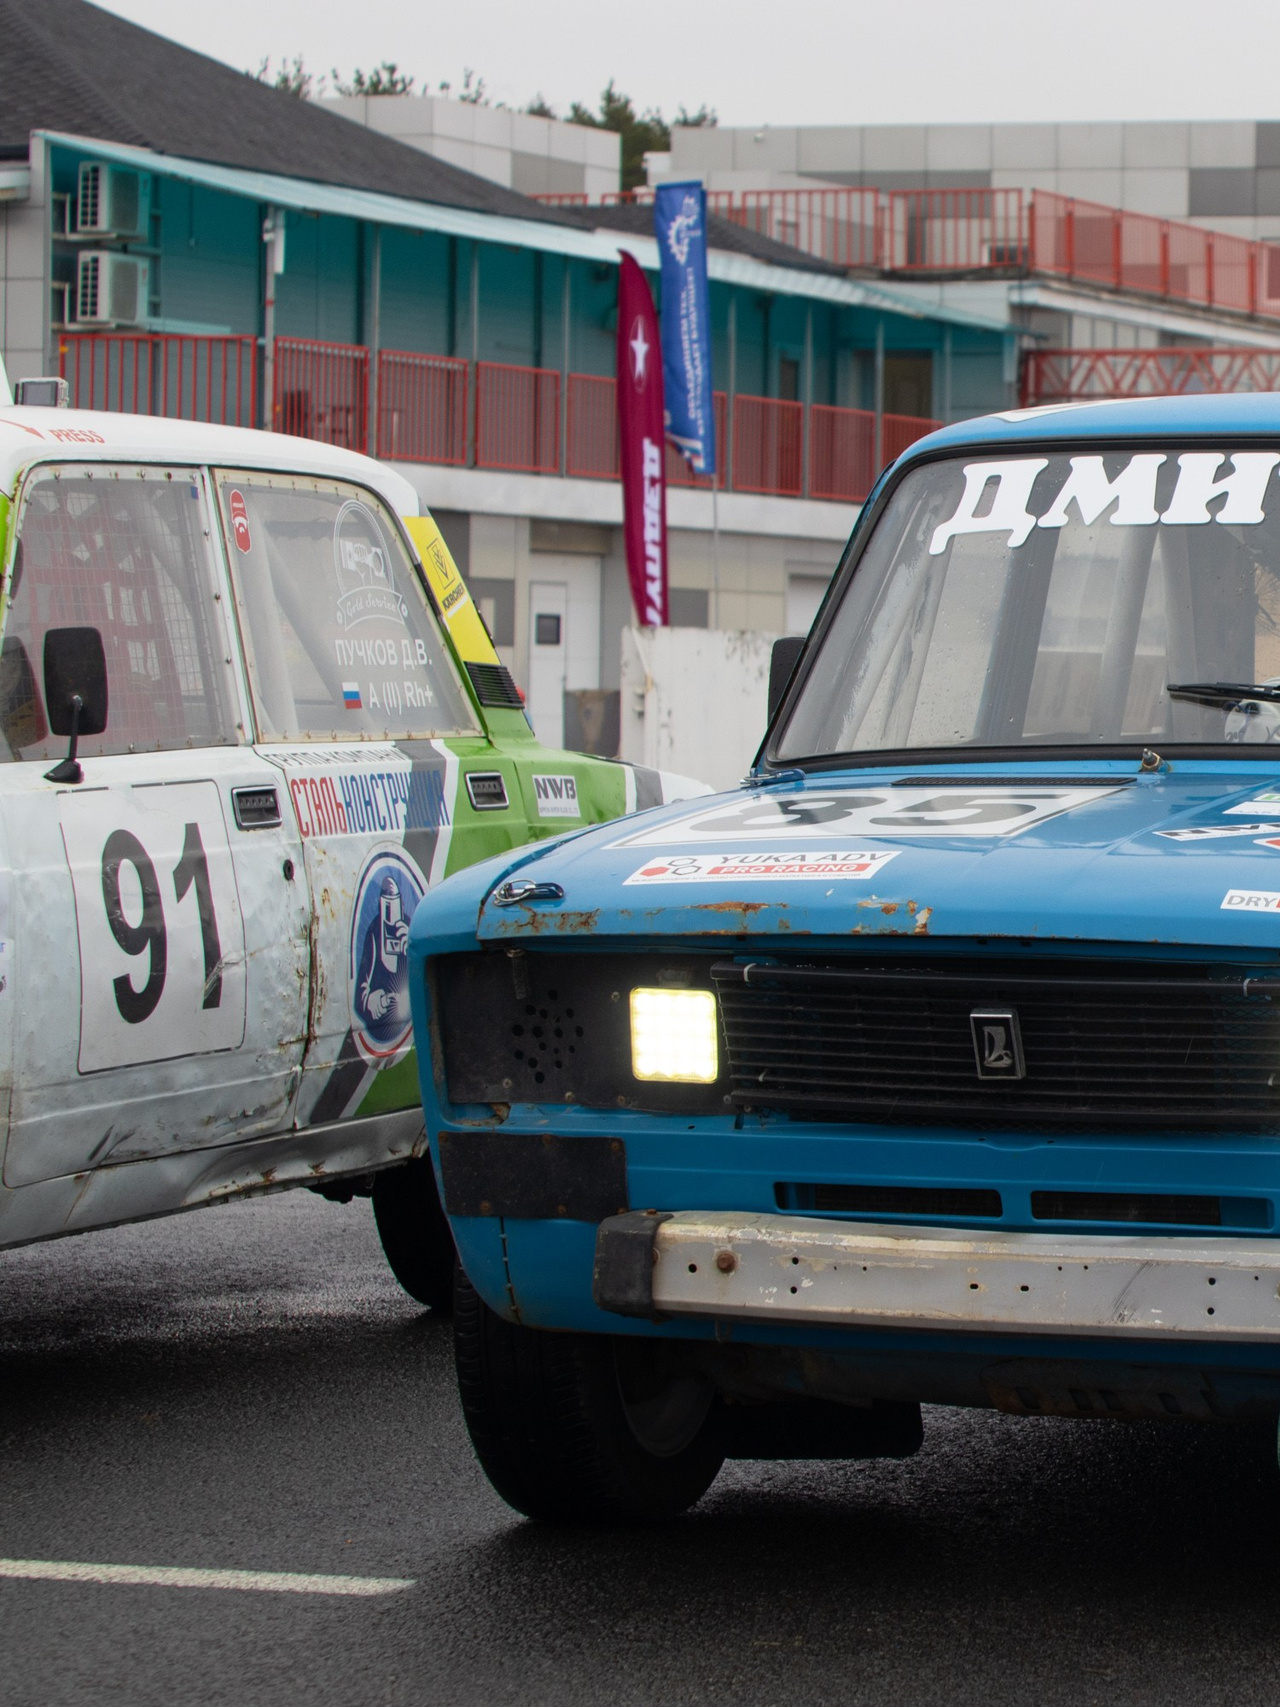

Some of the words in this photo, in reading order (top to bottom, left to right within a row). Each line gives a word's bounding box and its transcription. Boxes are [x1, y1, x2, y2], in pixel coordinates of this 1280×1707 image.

[48, 428, 105, 443] PRESS
[335, 639, 398, 666] ПУЧКОВ
[402, 639, 432, 670] Д.В.
[403, 682, 433, 708] Rh+
[261, 752, 332, 768] ГРУППА
[534, 778, 577, 799] NWB
[689, 794, 1068, 832] 85
[720, 854, 807, 864] YUKA
[815, 853, 892, 862] ADV
[720, 866, 764, 875] PRO
[771, 864, 859, 873] RACING
[102, 822, 222, 1024] 91
